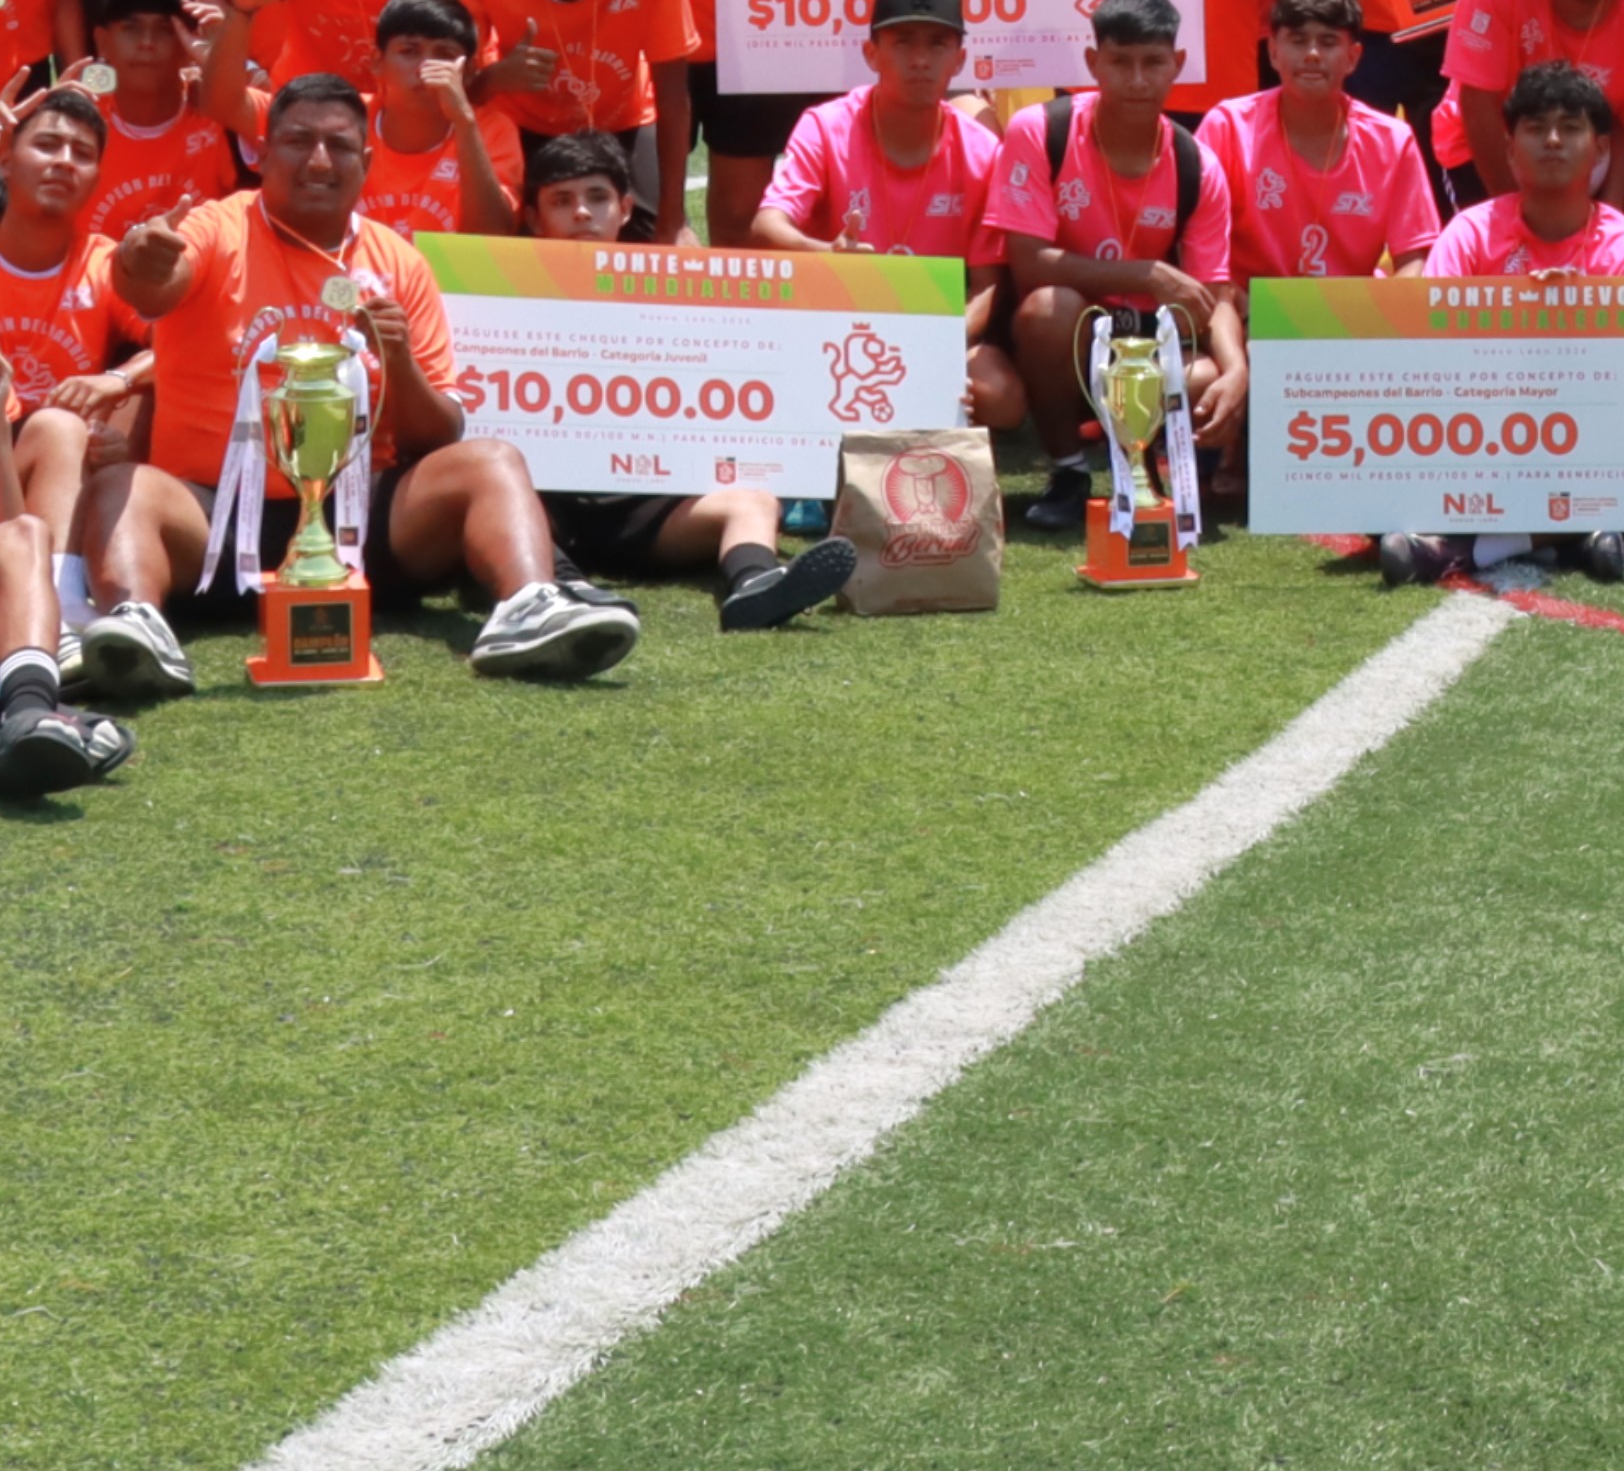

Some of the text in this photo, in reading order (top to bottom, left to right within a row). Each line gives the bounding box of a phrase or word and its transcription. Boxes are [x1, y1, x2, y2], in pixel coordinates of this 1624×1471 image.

[1298, 224, 1328, 275] 2
[595, 251, 792, 278] PONTE NUEVO
[1429, 286, 1513, 306] PONTE
[529, 345, 548, 356] del
[551, 346, 589, 358] Barrio
[664, 350, 707, 363] Juvenil
[1469, 372, 1497, 381] POR
[453, 364, 775, 432] $10,000.00
[1383, 387, 1402, 397] del
[1405, 387, 1442, 397] Barrio
[1519, 386, 1558, 398] Mayor
[1286, 408, 1578, 467] $5,000.00
